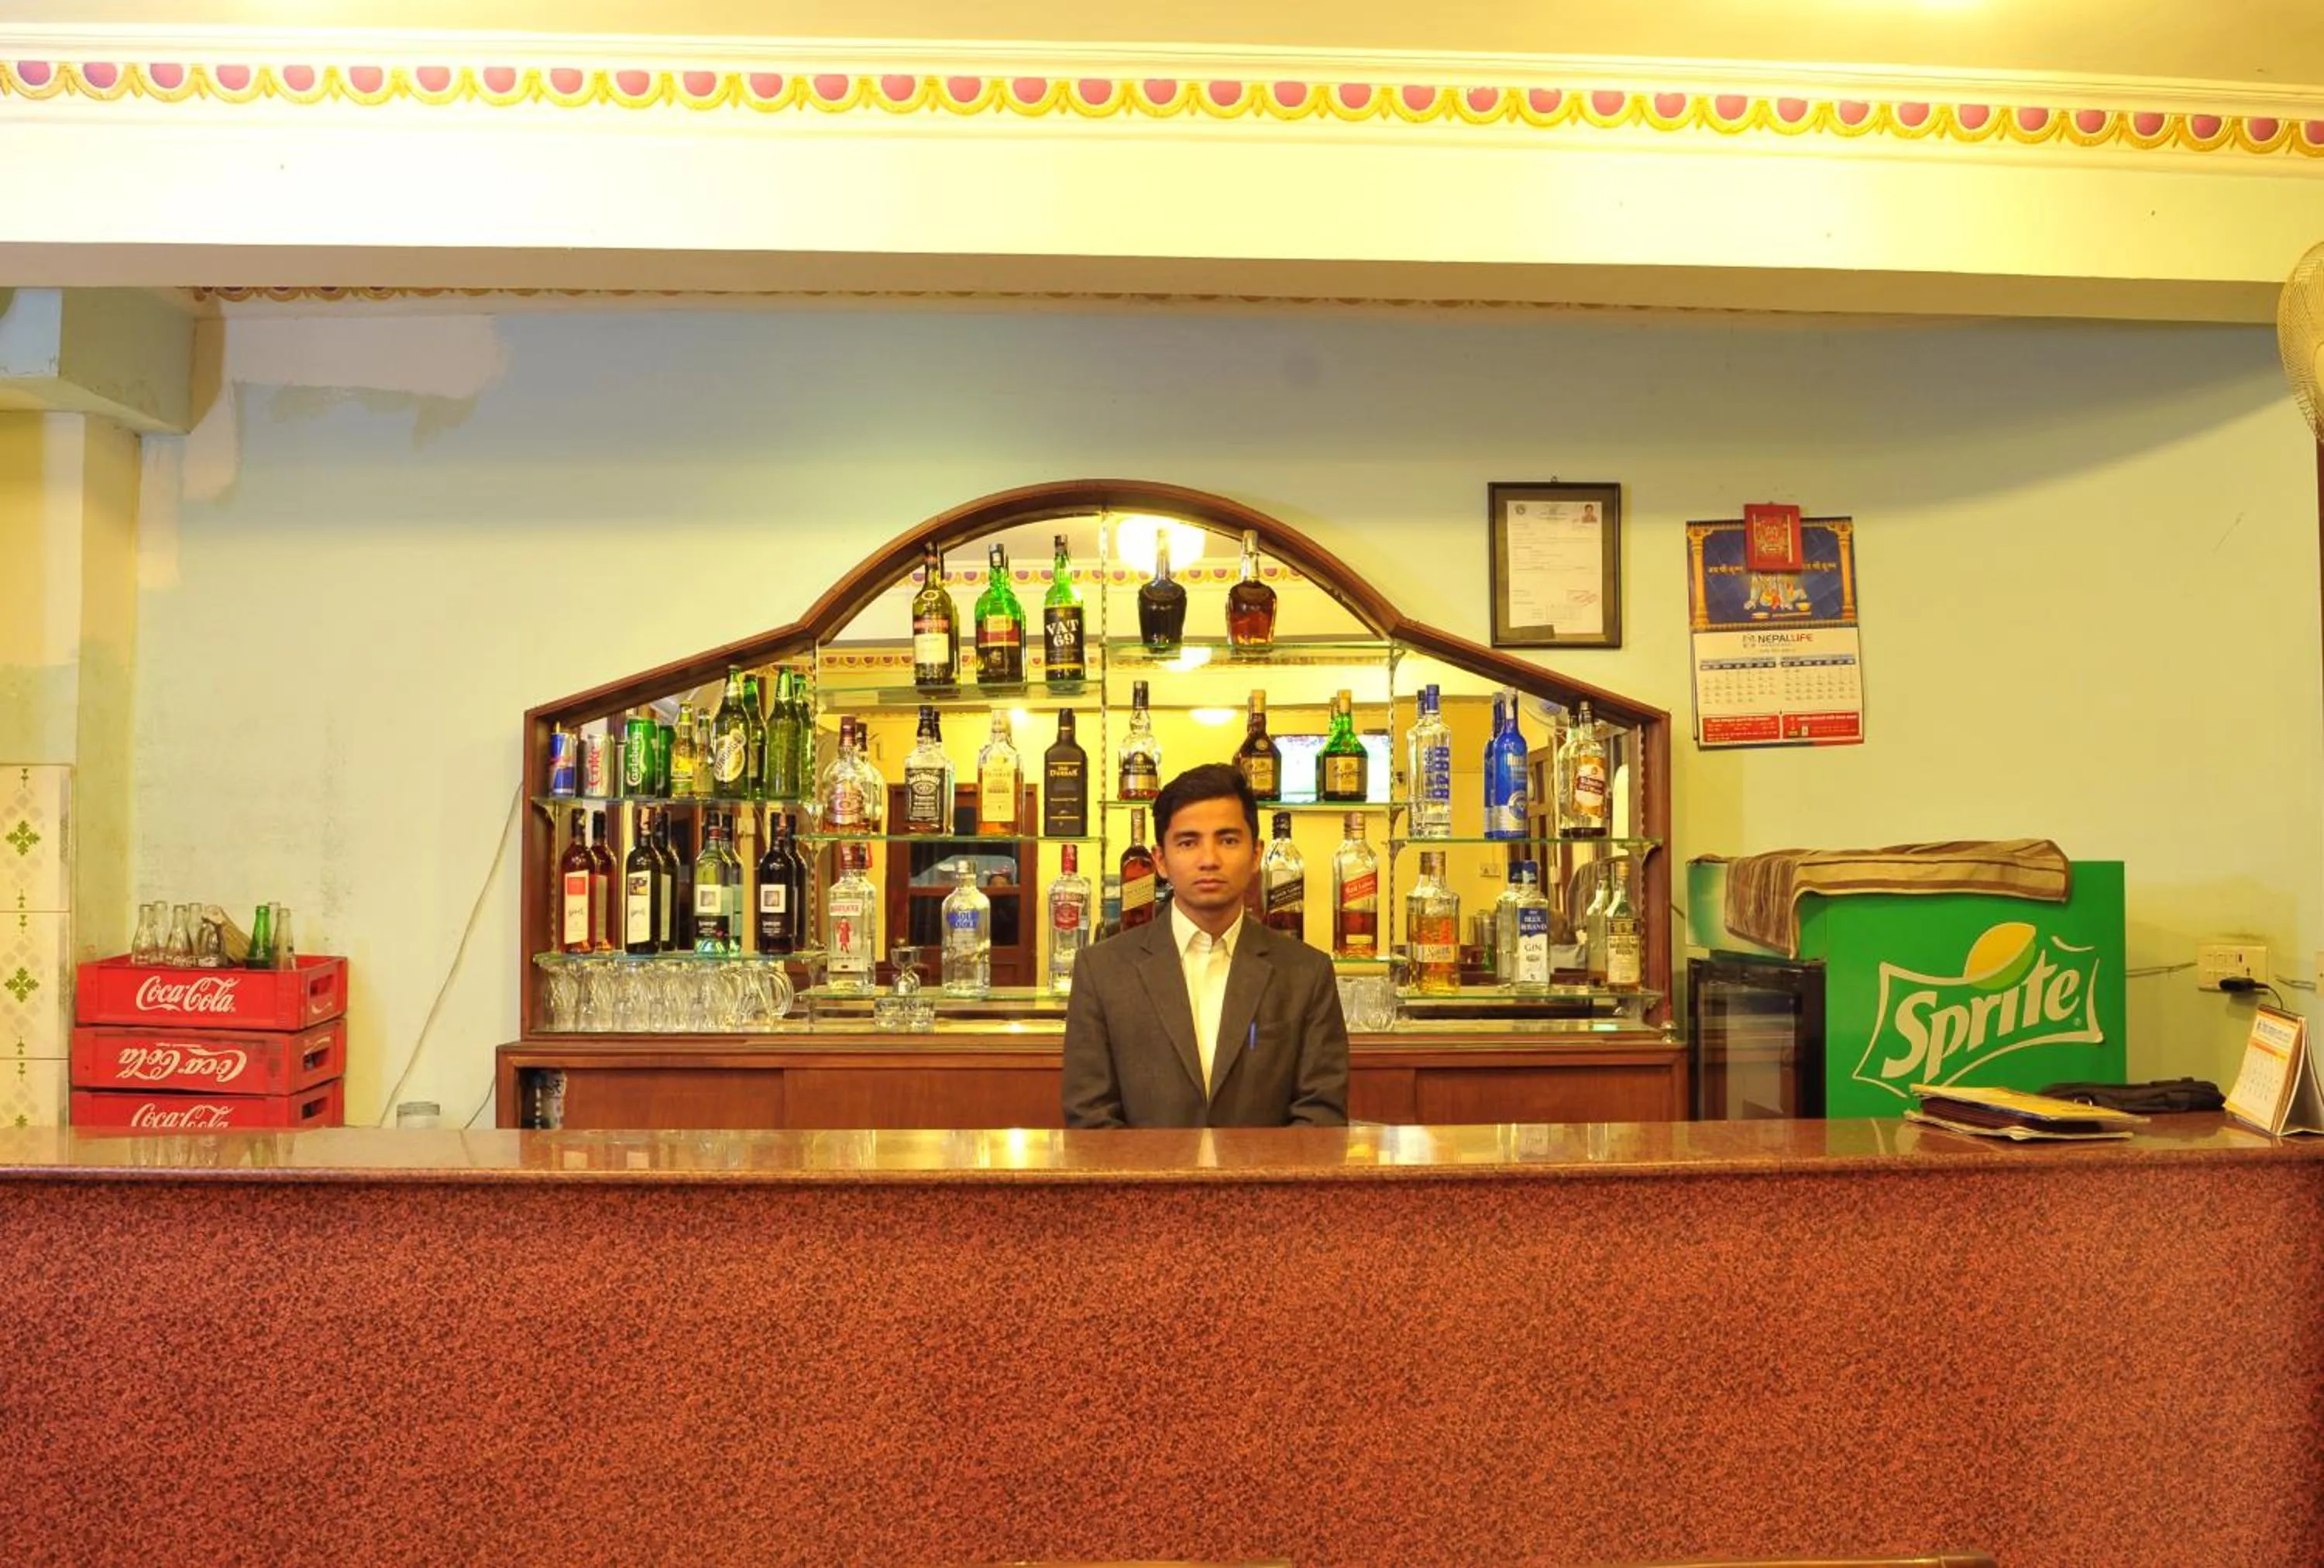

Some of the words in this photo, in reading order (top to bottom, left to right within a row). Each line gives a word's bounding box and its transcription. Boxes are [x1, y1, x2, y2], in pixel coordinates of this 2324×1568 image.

[1046, 619, 1079, 635] VAT
[1054, 633, 1075, 647] 69
[136, 975, 241, 1013] Coca-Cola
[1881, 948, 2080, 1085] Sprite
[116, 1042, 247, 1082] Coca-Cola
